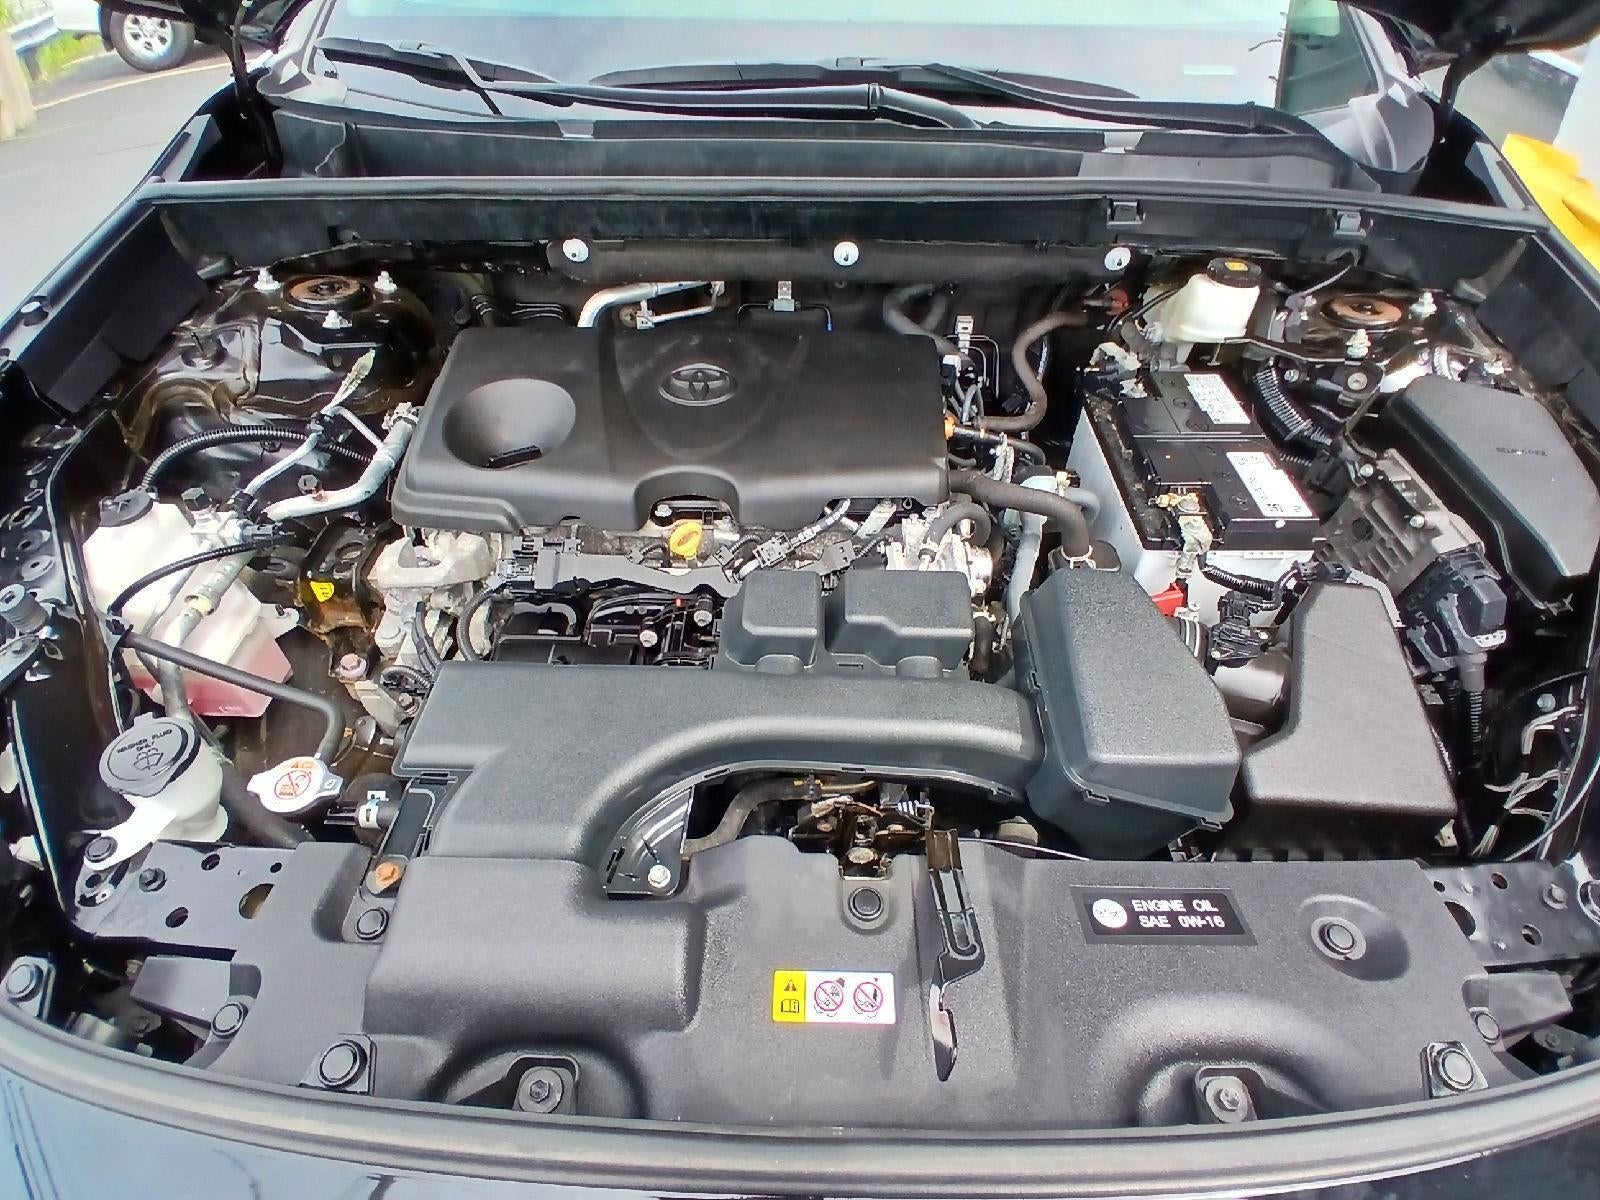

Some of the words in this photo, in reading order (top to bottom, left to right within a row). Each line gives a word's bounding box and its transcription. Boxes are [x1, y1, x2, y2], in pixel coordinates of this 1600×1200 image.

[1131, 899, 1187, 912] ENGINE
[1192, 899, 1219, 912] OIL
[1139, 915, 1172, 928] SAE
[1177, 915, 1226, 928] 0W-16
